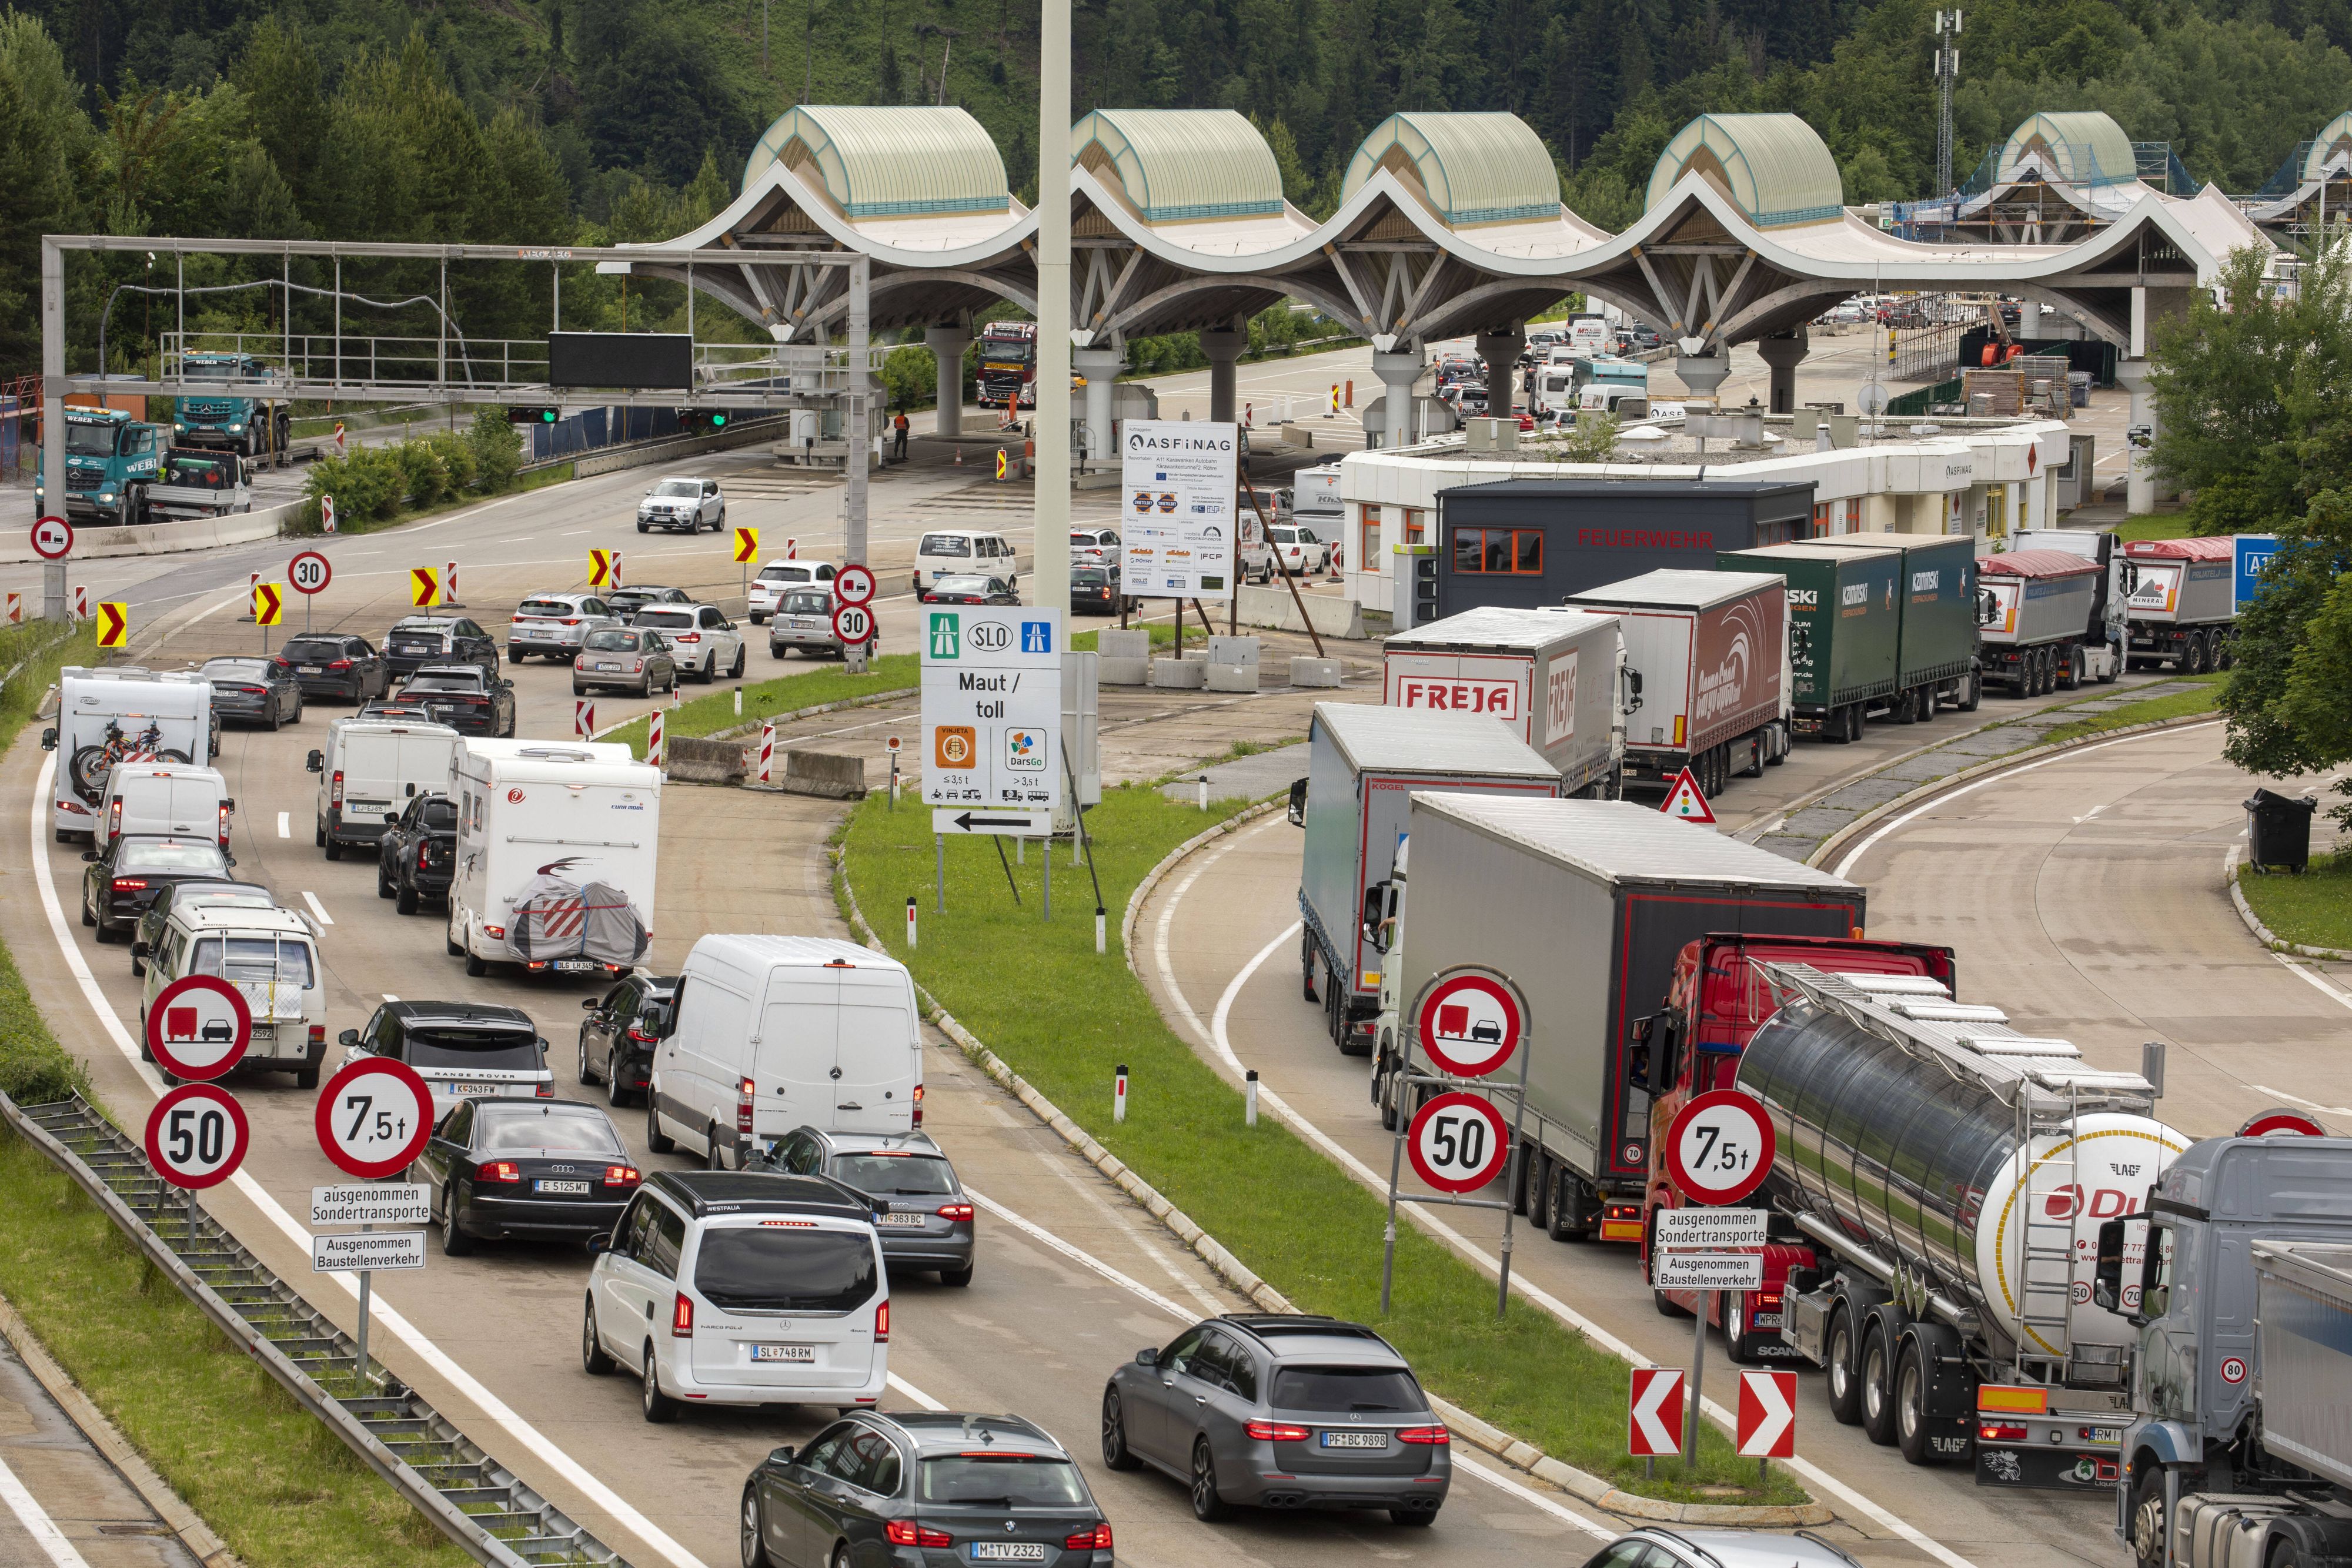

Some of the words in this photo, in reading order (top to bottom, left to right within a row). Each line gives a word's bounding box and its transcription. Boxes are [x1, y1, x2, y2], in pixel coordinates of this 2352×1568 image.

[1578, 529, 1713, 549] FEUERWEHR
[298, 563, 319, 583] 30
[843, 613, 863, 633] 30
[975, 627, 1006, 647] SLO
[959, 673, 1006, 691] Maut
[1012, 673, 1021, 694] /
[1406, 684, 1508, 716] FREJA
[1548, 666, 1576, 734] FREJA
[976, 700, 1004, 718] toll
[1011, 757, 1043, 766] DarsGo
[951, 775, 963, 784] 3,5
[1022, 777, 1033, 786] 3,5
[253, 1029, 272, 1038] 2592
[169, 1109, 224, 1164] 50
[1432, 1115, 1485, 1170] 50
[1629, 1149, 1639, 1158] 70
[2116, 1164, 2136, 1176] LAG
[543, 1182, 549, 1191] E
[553, 1182, 574, 1192] 5125
[576, 1183, 587, 1192] MT
[324, 1189, 419, 1204] ausgenommen
[313, 1205, 428, 1222] Sondertransporte
[894, 1215, 909, 1223] 363
[911, 1215, 921, 1223] BC
[1669, 1212, 1757, 1228] ausgenommen
[1658, 1228, 1765, 1245] Sondertransporte
[327, 1237, 412, 1253] Ausgenommen
[318, 1252, 420, 1268] Baustellenverkehr
[1670, 1258, 1749, 1273] Ausgenommen
[1661, 1273, 1756, 1286] Baustellenverkehr
[2073, 1288, 2087, 1298] 50
[1760, 1314, 1778, 1323] WPR
[761, 1348, 771, 1356] SL
[779, 1348, 797, 1358] 748
[799, 1349, 811, 1358] RM
[2227, 1365, 2240, 1375] 80
[1329, 1435, 1341, 1445] PF
[1348, 1435, 1360, 1445] BC
[1362, 1435, 1386, 1445] 9898
[1938, 1437, 1960, 1452] LAG
[980, 1544, 988, 1556] M
[995, 1544, 1011, 1556] TV
[1013, 1545, 1043, 1557] 2323
